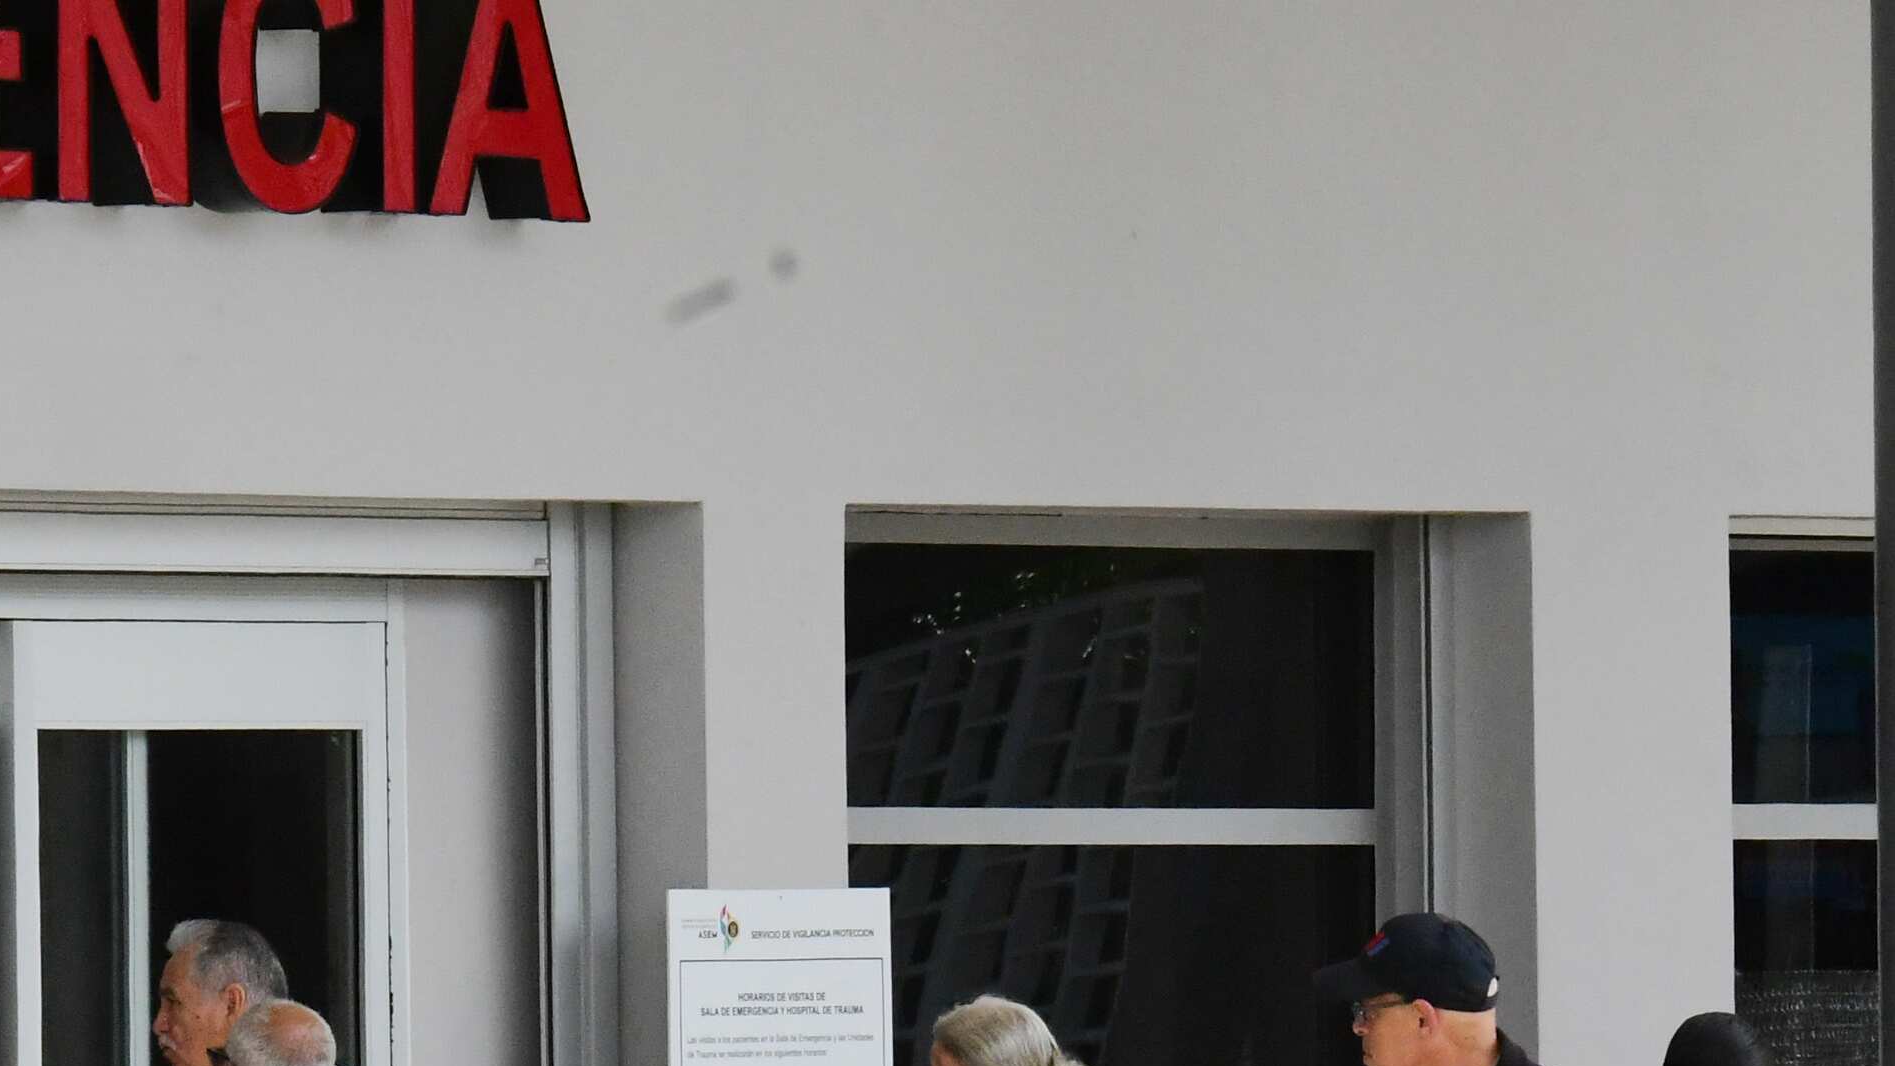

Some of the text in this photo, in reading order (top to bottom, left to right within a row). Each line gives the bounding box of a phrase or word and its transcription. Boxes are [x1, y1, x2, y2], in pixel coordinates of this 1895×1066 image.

[698, 930, 718, 938] ASEM
[752, 929, 874, 939] SERVICIO DE VIGILANCIA PROTECCION
[738, 992, 826, 1002] HORARIOS DE VISITAS DE
[700, 1005, 864, 1016] SALA DE EMERGENCIA Y HOSPITAL DE TRAUMA
